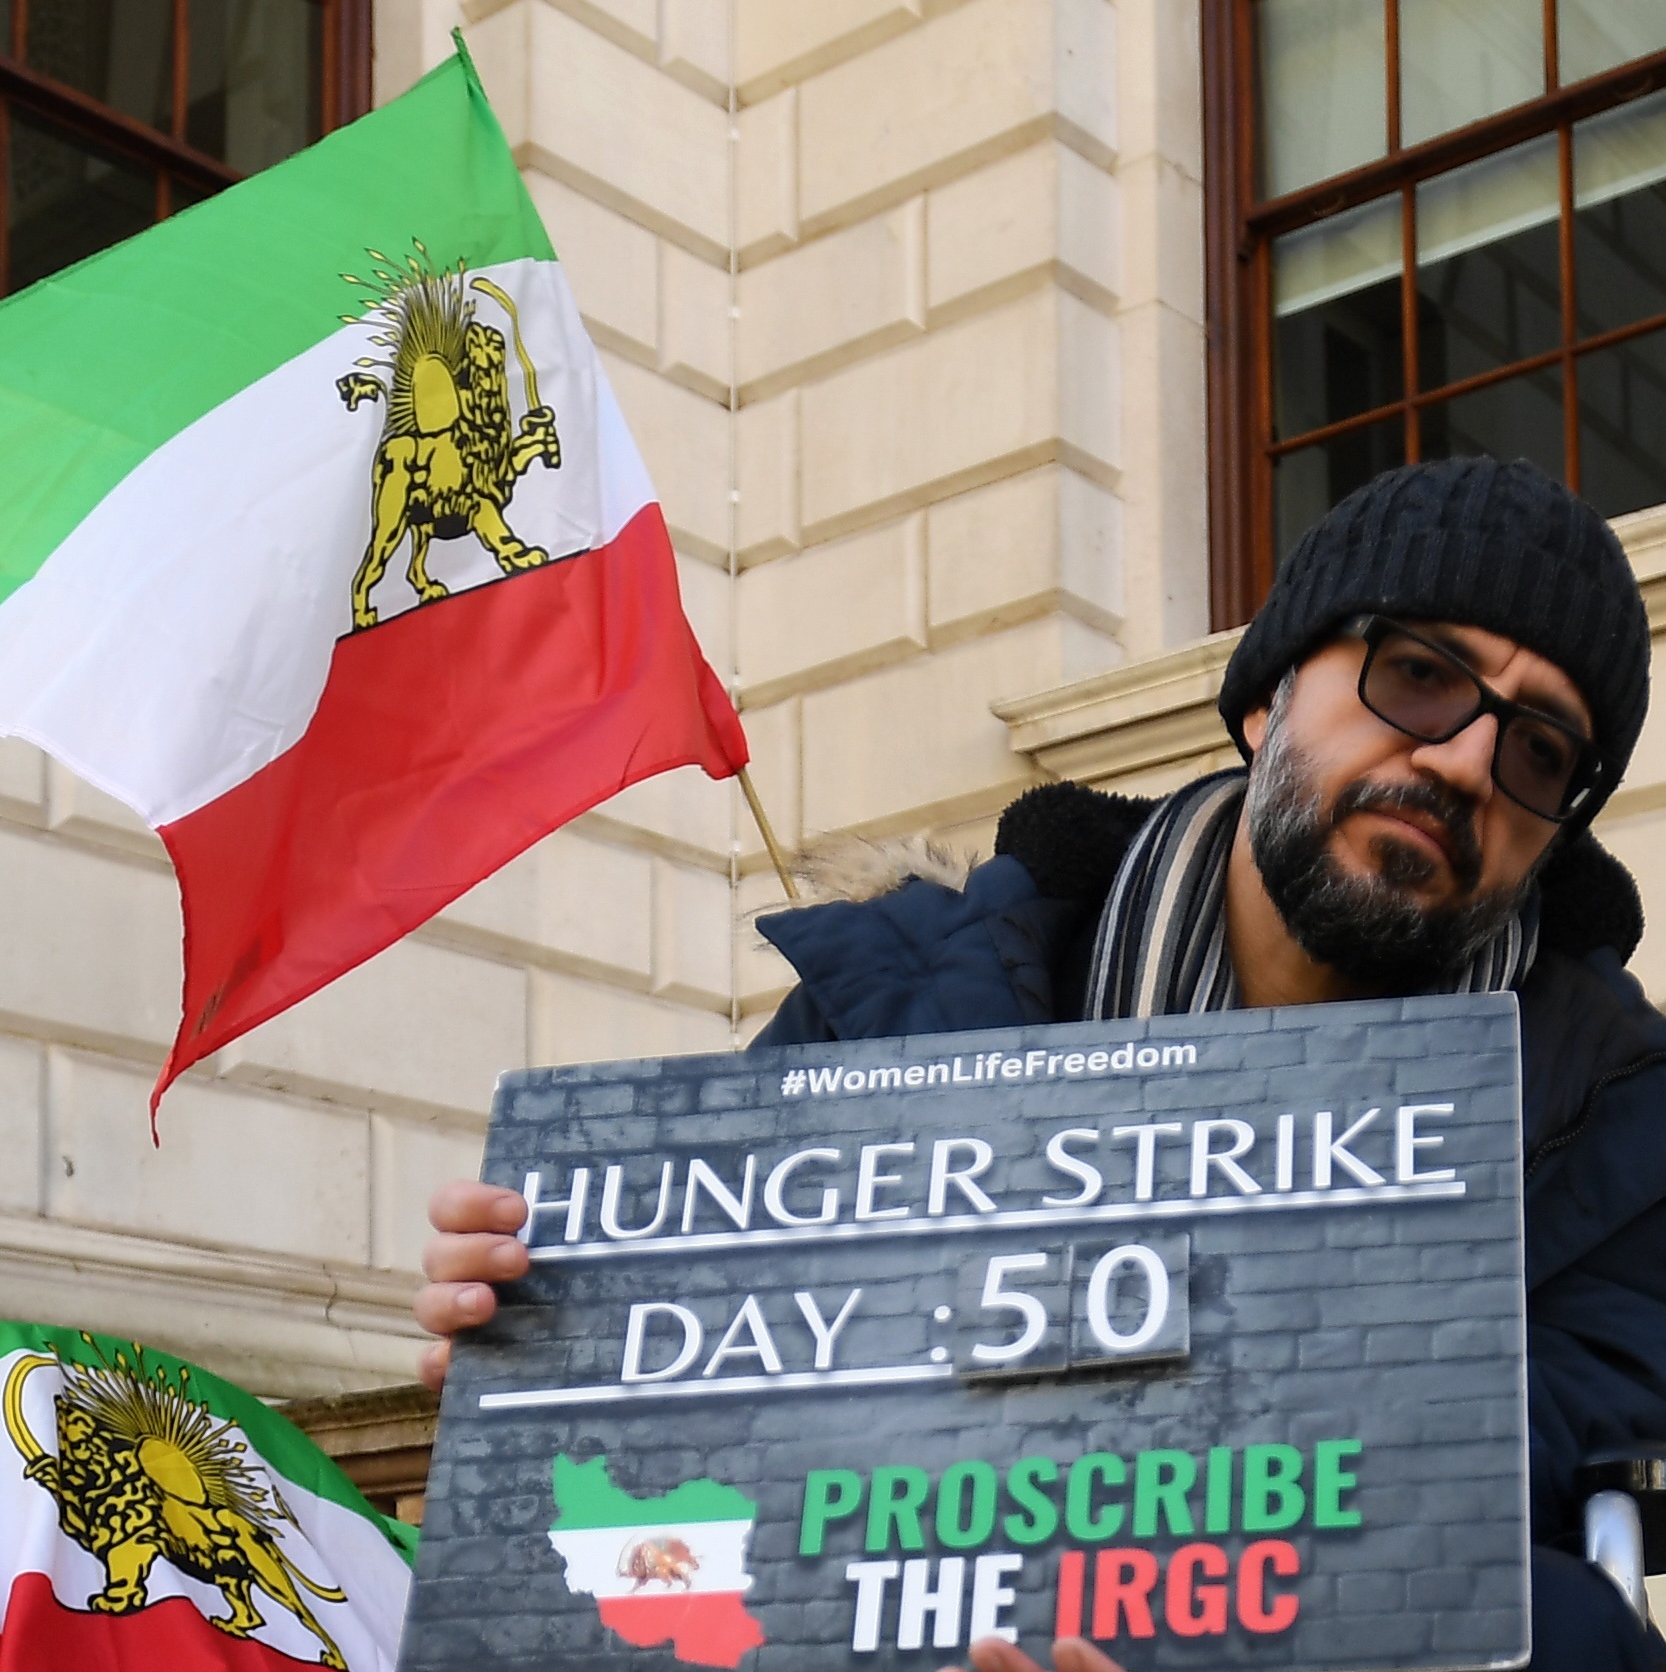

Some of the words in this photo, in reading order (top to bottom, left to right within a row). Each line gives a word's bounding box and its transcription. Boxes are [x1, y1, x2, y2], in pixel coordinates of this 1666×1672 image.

[780, 1039, 1198, 1097] #WomenLifeFreedom
[519, 1136, 997, 1246] HUNGER
[1042, 1102, 1457, 1208] STRIKE
[619, 1287, 864, 1384] DAY
[799, 1438, 1364, 1555] PROSCRIBE
[845, 1553, 1024, 1652] THE
[1052, 1540, 1299, 1640] IRGC
